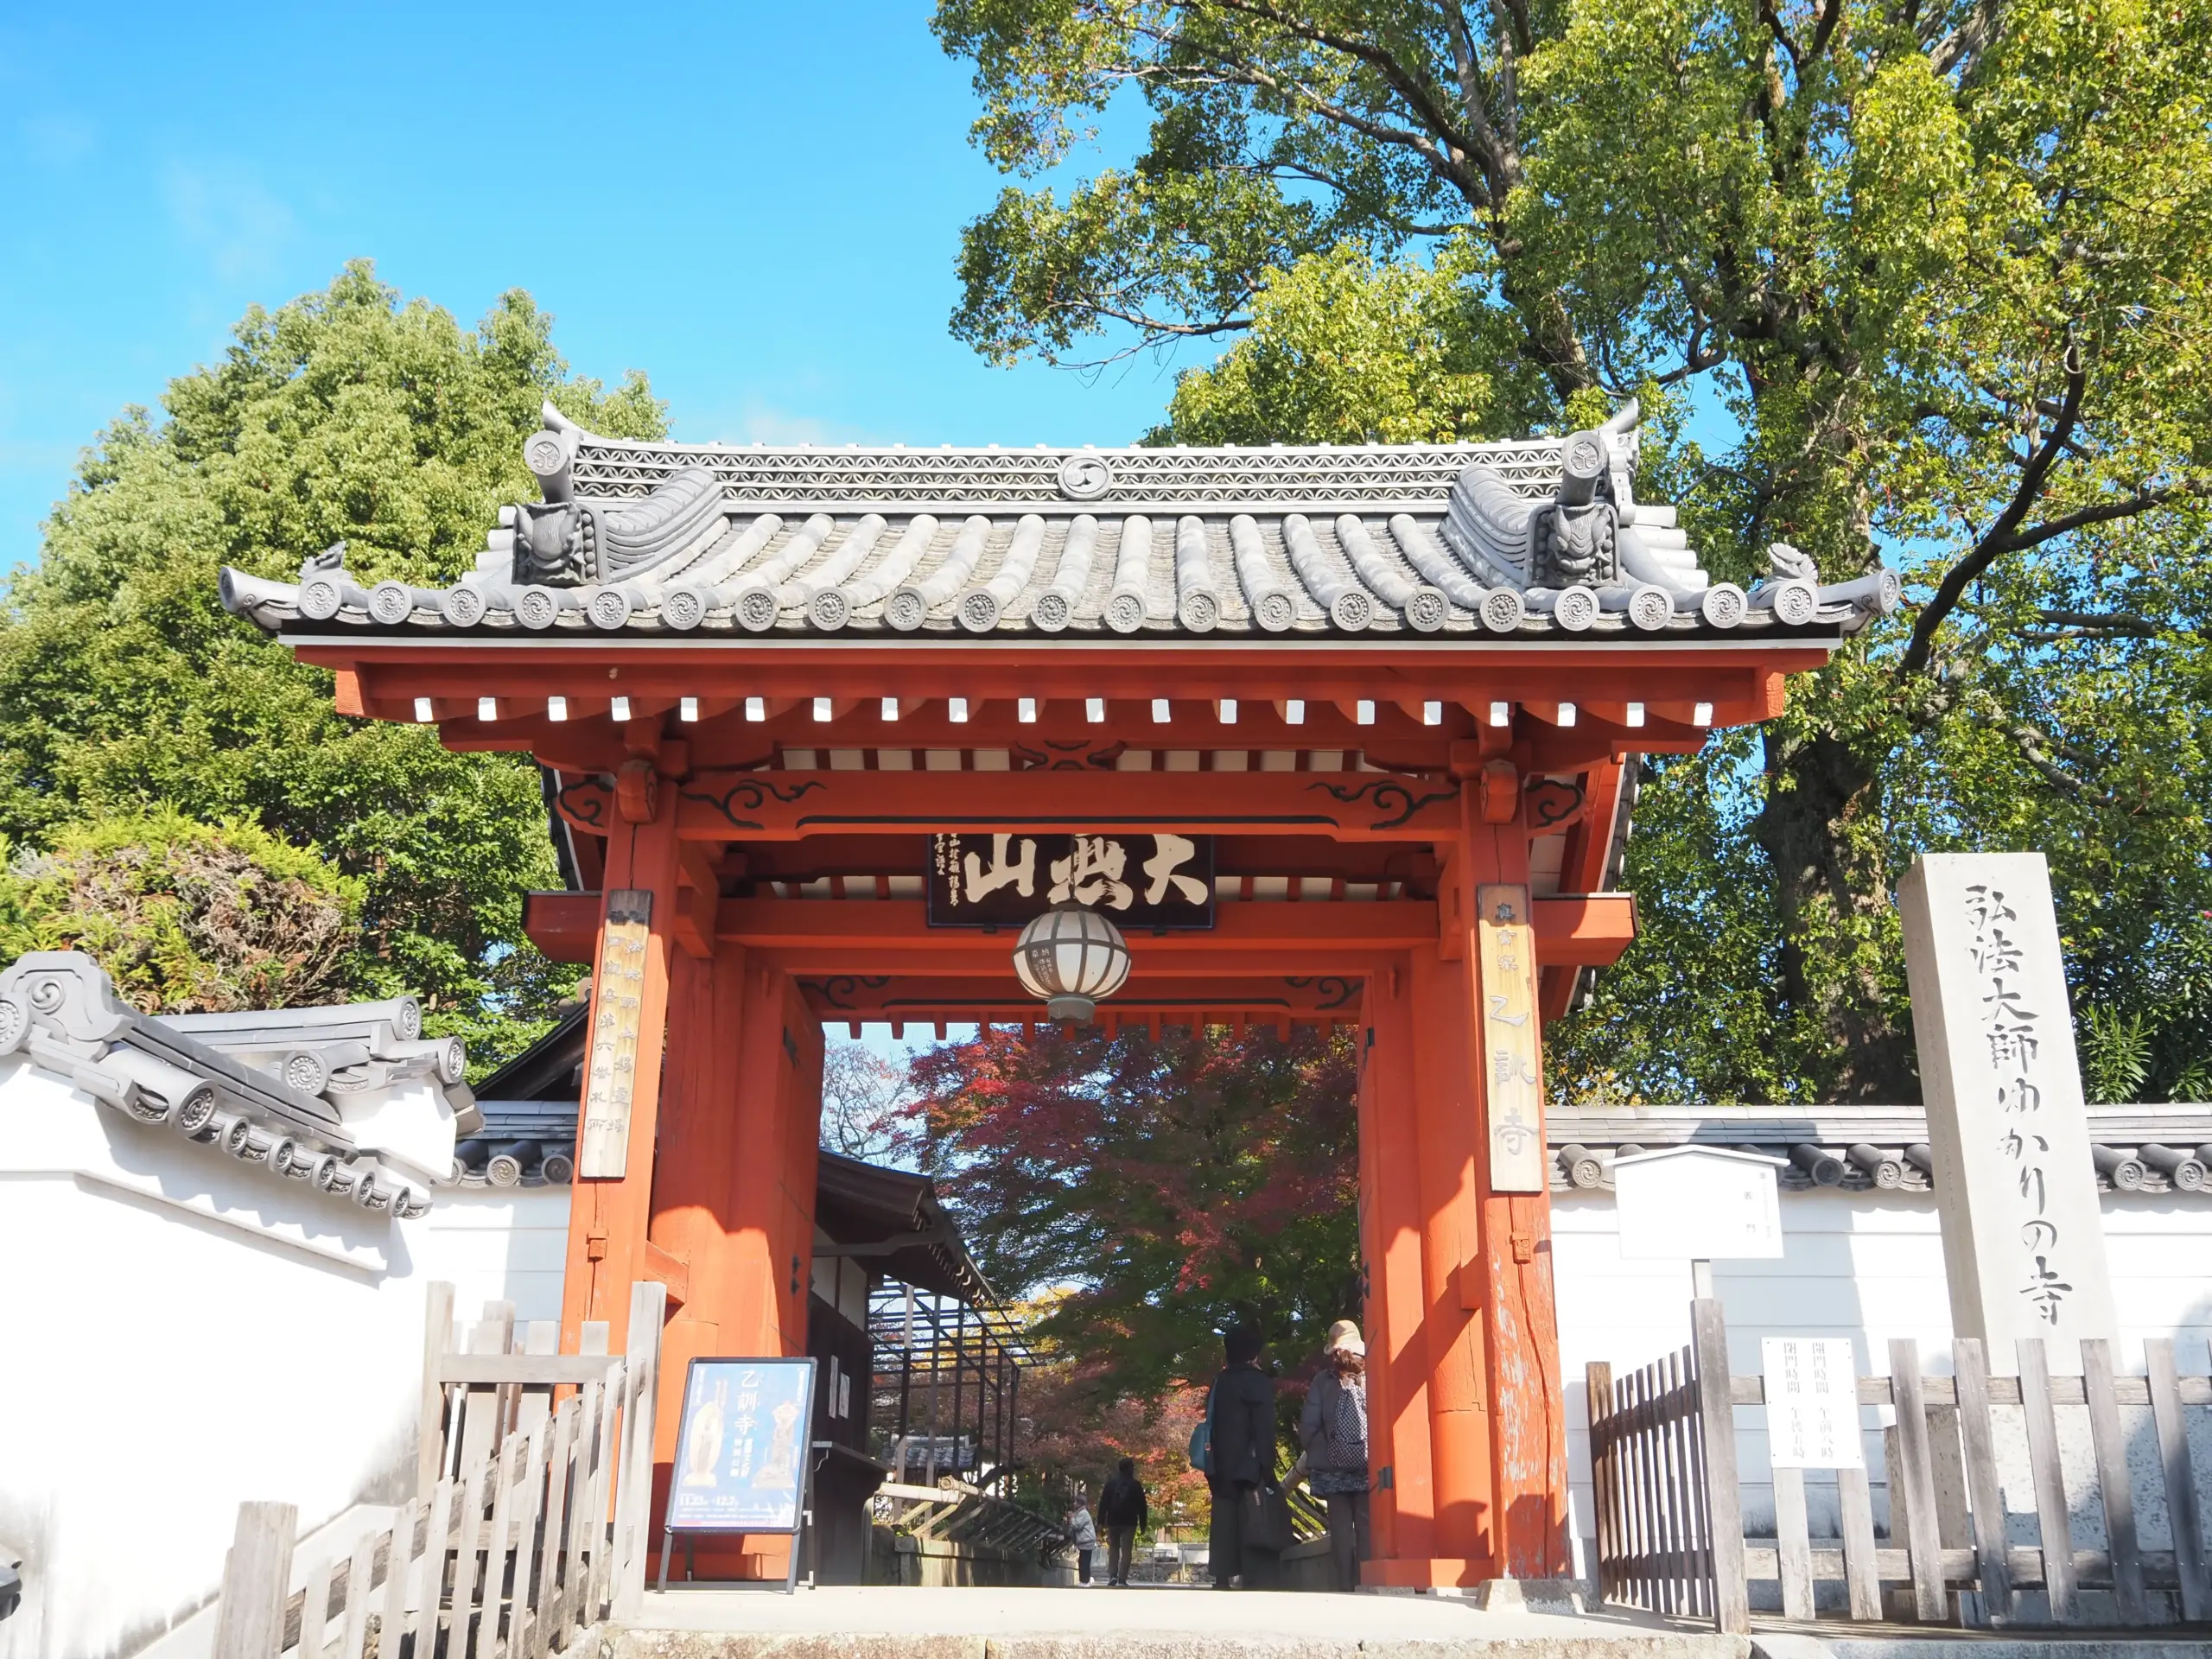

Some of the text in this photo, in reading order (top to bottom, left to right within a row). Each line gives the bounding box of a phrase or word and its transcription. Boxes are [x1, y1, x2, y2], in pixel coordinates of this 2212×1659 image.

[1489, 995, 1539, 1156] 乙訓寺
[1964, 884, 2073, 1325] 弘法大師ゆかりの寺
[735, 1370, 760, 1435] 乙訓寺
